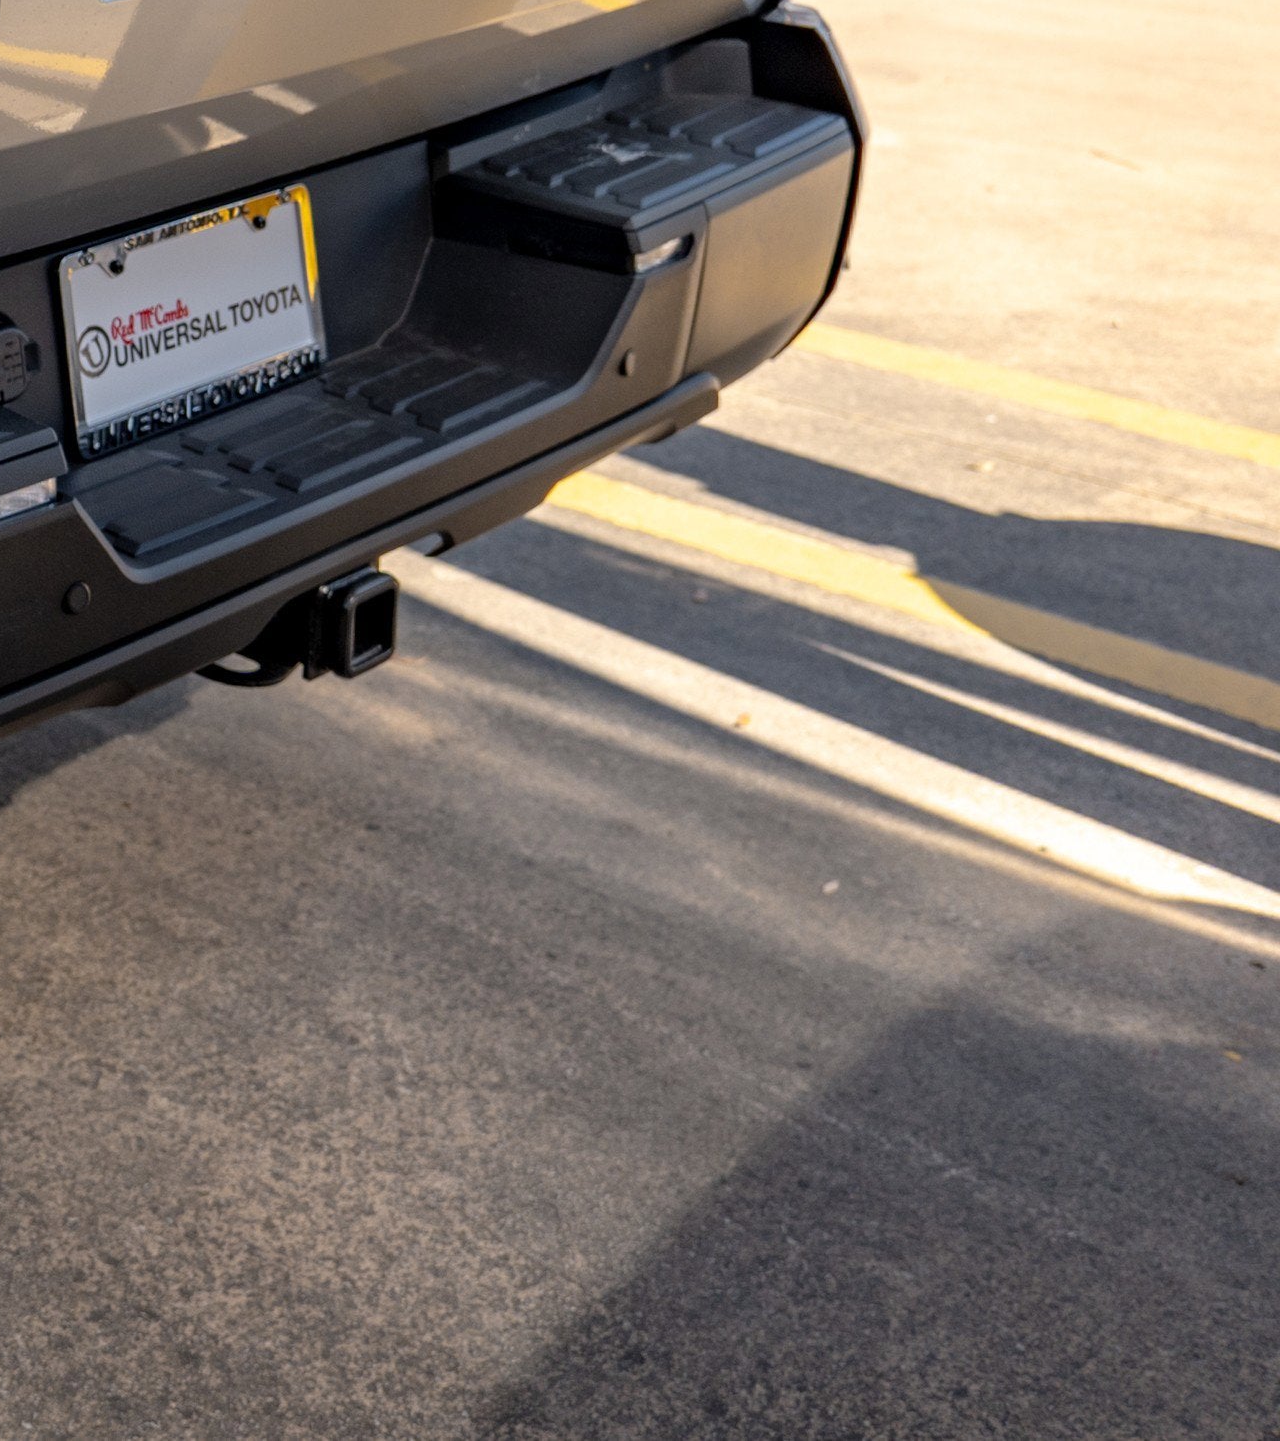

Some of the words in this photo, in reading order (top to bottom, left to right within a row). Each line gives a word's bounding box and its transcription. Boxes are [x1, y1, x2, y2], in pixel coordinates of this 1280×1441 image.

[124, 231, 154, 251] SAN
[111, 314, 135, 345] Red
[114, 311, 228, 367] UNIVERSAL
[228, 283, 303, 326] TOYOTA
